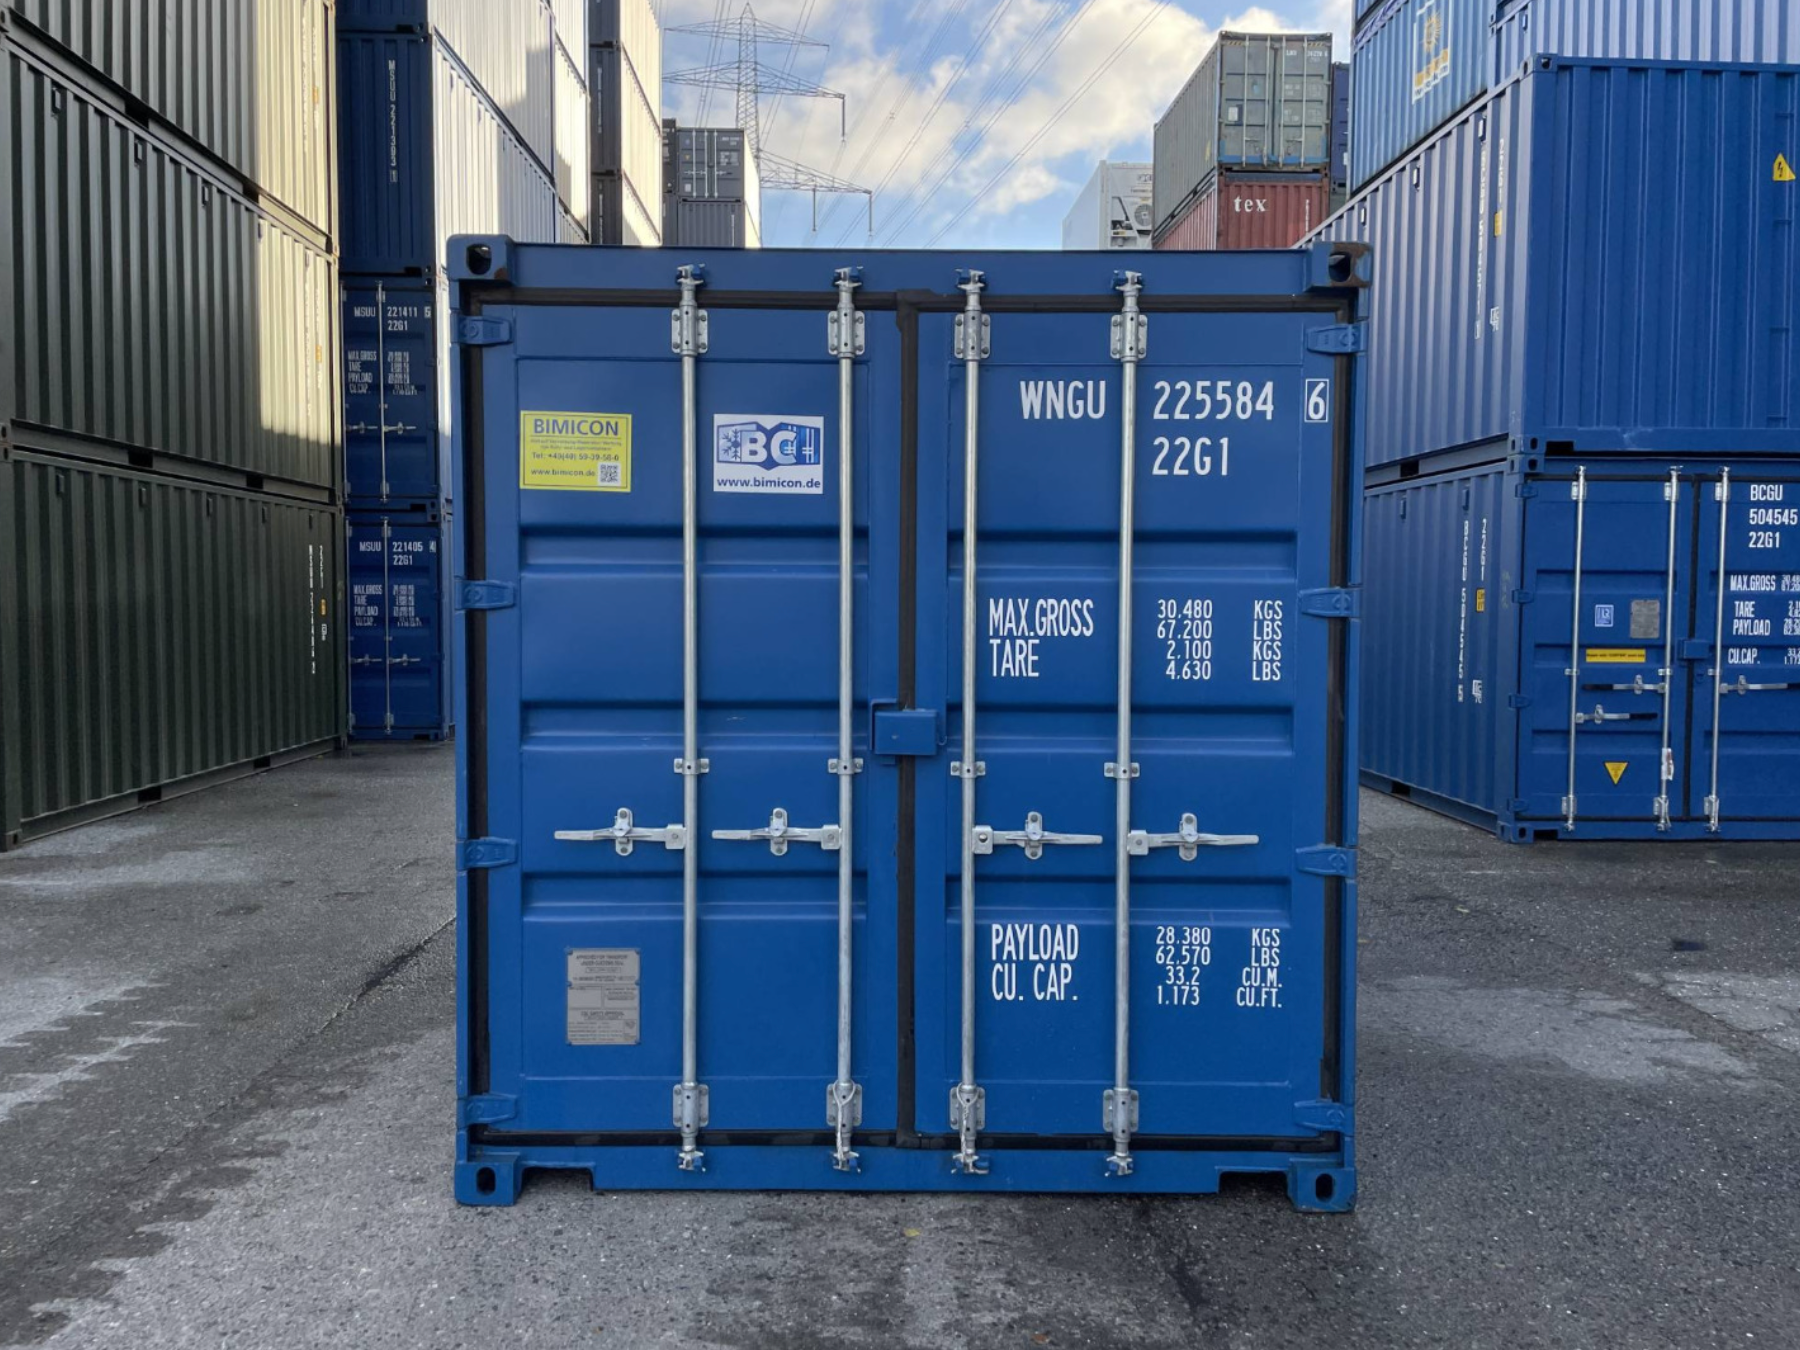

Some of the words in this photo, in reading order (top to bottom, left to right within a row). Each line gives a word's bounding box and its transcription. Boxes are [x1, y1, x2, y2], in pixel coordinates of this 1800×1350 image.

[1234, 195, 1267, 213] tex
[353, 306, 376, 318] MSUU
[387, 306, 418, 318] 221411
[387, 320, 408, 331] 22G1
[1020, 380, 1107, 420] WNGU
[1153, 380, 1274, 421] 225584
[1307, 381, 1327, 421] 6
[533, 418, 619, 436] BIMICON
[1152, 437, 1229, 476] 22G1
[530, 468, 595, 477] www.bimicon.de
[717, 477, 821, 489] www.bimicon.de
[1750, 484, 1783, 501] BCGU
[1749, 508, 1798, 525] 504545
[360, 541, 382, 552] MSUU
[392, 541, 423, 552] 221405
[1748, 531, 1780, 548] 22G1
[393, 555, 413, 566] 22G1
[1730, 574, 1776, 591] MAX.GROSS
[988, 598, 1094, 637] MAX.GROSS
[1254, 600, 1282, 619] KGS
[1734, 601, 1755, 617] TARE
[1253, 620, 1282, 640] LBS
[1733, 619, 1771, 636] PAYLOAD
[989, 639, 1040, 677] TARE
[1253, 641, 1281, 660] KGS
[1252, 661, 1281, 680] LBS
[992, 924, 1079, 960] PAYLOAD
[1252, 928, 1280, 947] KGS
[1251, 947, 1280, 967] LBS
[992, 963, 1024, 1000] CU.
[1033, 963, 1078, 1000] CAP.
[1166, 965, 1200, 985] 33.2
[1242, 967, 1283, 988] CU.M.
[1236, 987, 1282, 1008] CU.FT.
